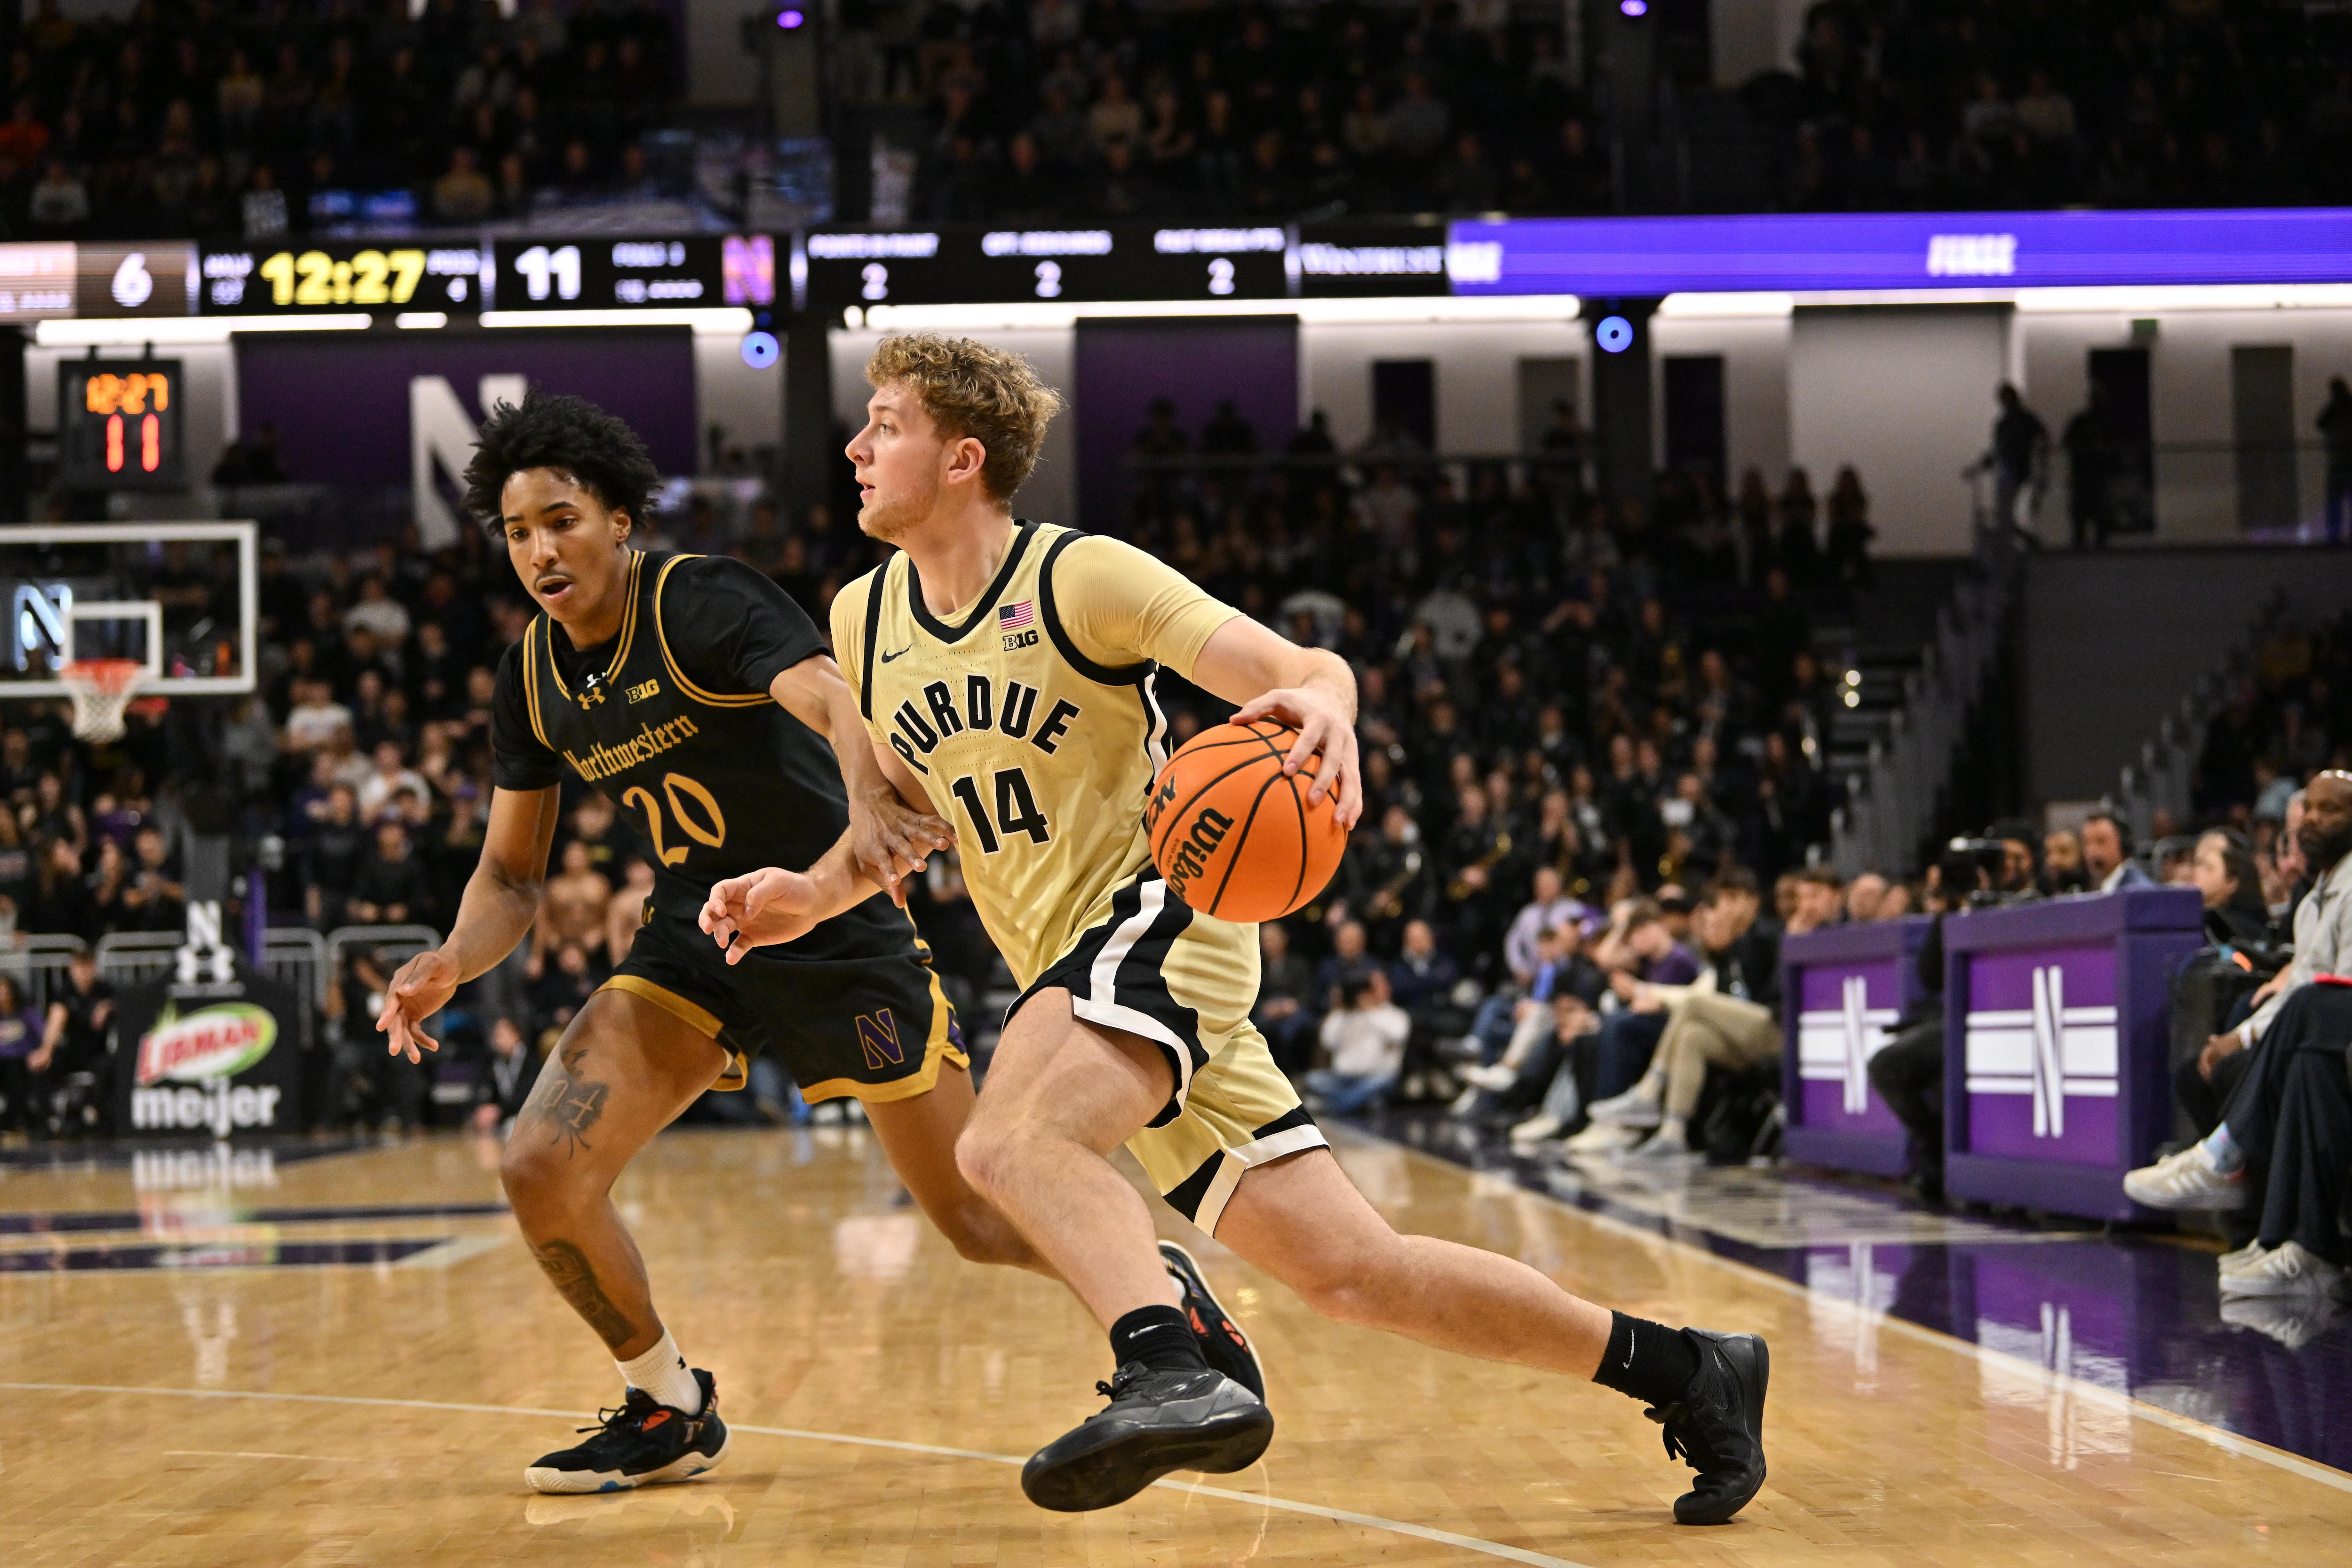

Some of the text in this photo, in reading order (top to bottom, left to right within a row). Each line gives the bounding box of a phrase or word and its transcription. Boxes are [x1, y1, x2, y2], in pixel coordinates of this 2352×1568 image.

[111, 253, 153, 307] 6
[261, 250, 426, 305] 12:27
[515, 246, 581, 300] 11
[722, 234, 776, 304] N
[861, 263, 888, 300] 2
[1035, 261, 1062, 297] 2
[1208, 258, 1235, 295] 2
[107, 414, 159, 472] 11
[563, 715, 699, 782] Northwestern
[889, 673, 1082, 776] PURDUE
[622, 772, 726, 868] 20
[950, 765, 1053, 855] 14
[188, 899, 222, 946] N
[855, 1008, 904, 1069] N
[132, 1076, 281, 1138] meijer
